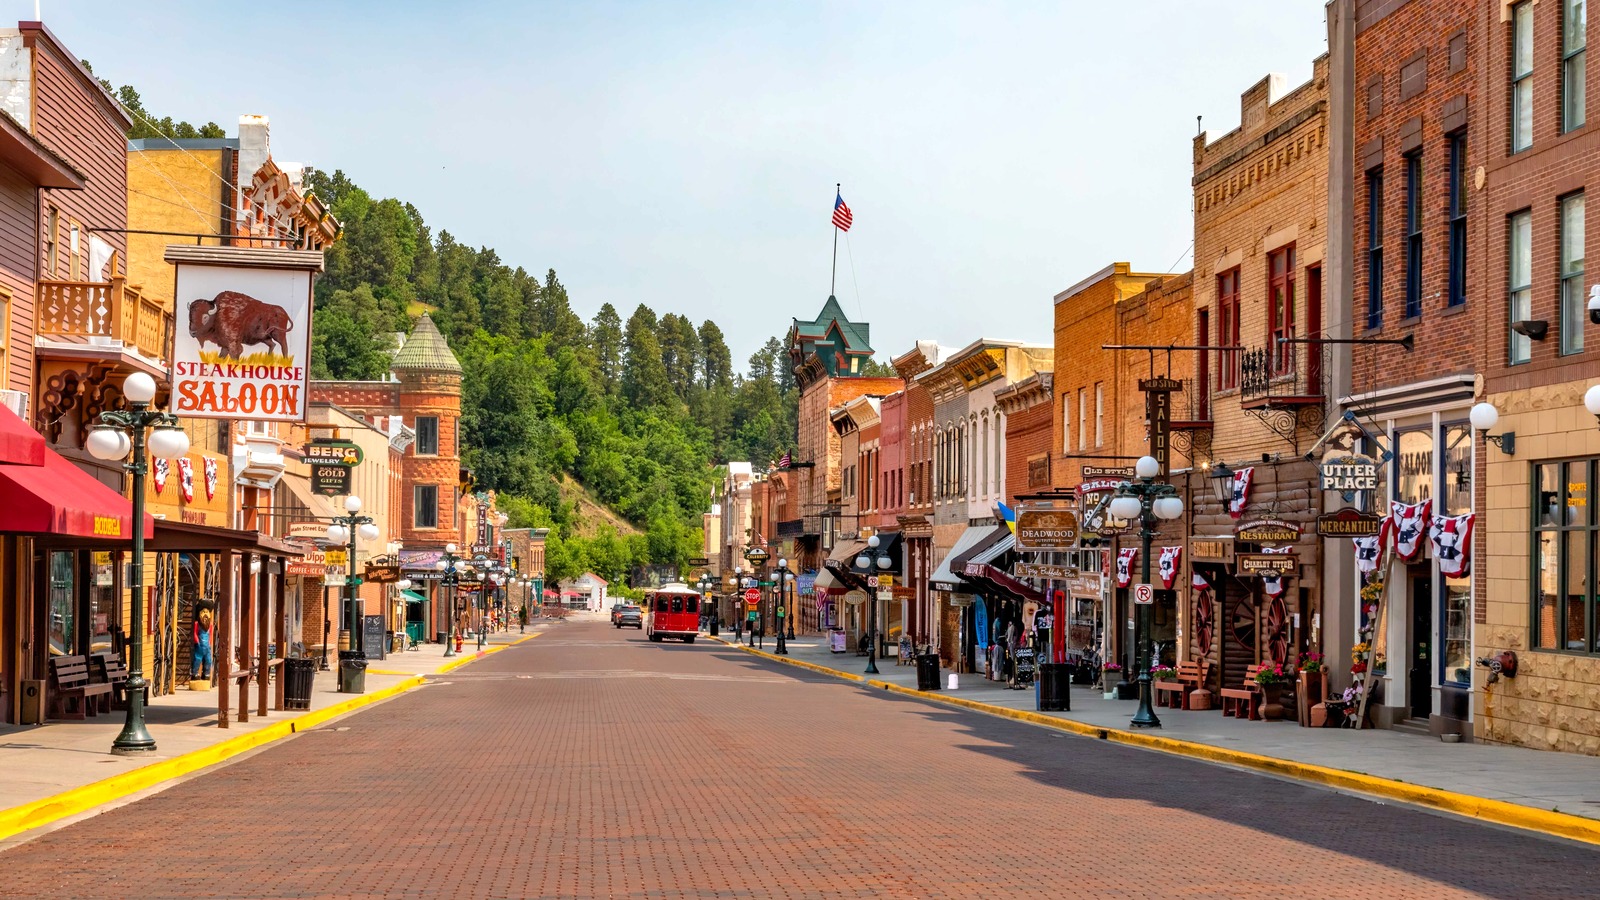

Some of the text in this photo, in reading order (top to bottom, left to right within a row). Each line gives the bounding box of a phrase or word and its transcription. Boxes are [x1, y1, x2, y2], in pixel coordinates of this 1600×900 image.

[176, 361, 303, 380] STEAKHOUSE
[1145, 380, 1178, 388] OLD STYLE
[177, 380, 300, 415] SALOON
[310, 446, 356, 458] BERG
[318, 470, 346, 478] GOLD
[1084, 467, 1134, 476] OLD STYLE
[1323, 464, 1377, 477] UTTER
[1323, 477, 1376, 489] PLACE
[94, 516, 121, 536] BODEGA
[1238, 520, 1267, 531] DEADWOOD
[1286, 523, 1299, 531] CLUB
[1320, 521, 1377, 533] MERCANTILE
[1022, 530, 1074, 538] DEADWOOD
[1240, 531, 1298, 540] RESTAURANT
